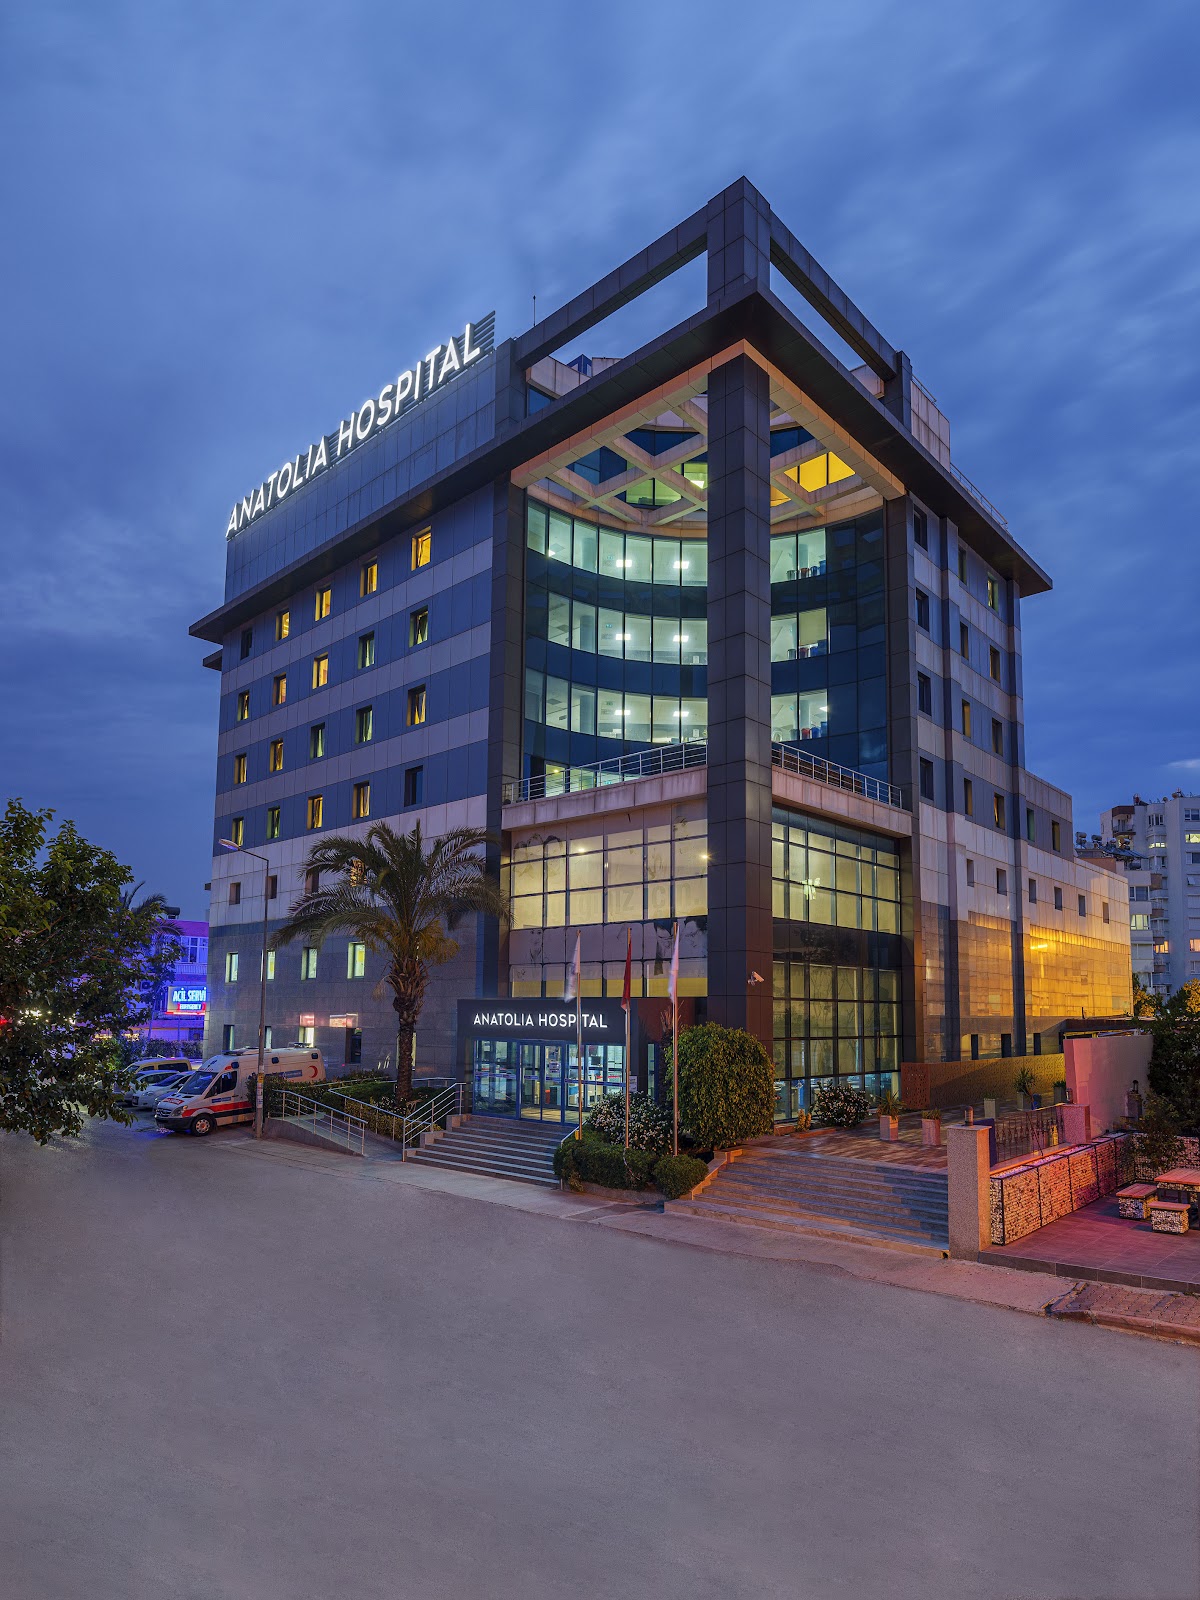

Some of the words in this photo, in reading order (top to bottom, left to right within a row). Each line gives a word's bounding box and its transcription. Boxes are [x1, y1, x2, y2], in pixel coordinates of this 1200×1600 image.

[225, 435, 329, 538] ANATOLIA
[337, 322, 481, 457] HOSPITAL
[473, 1012, 535, 1027] ANATOLIA
[538, 1013, 608, 1029] HOSPTAL
